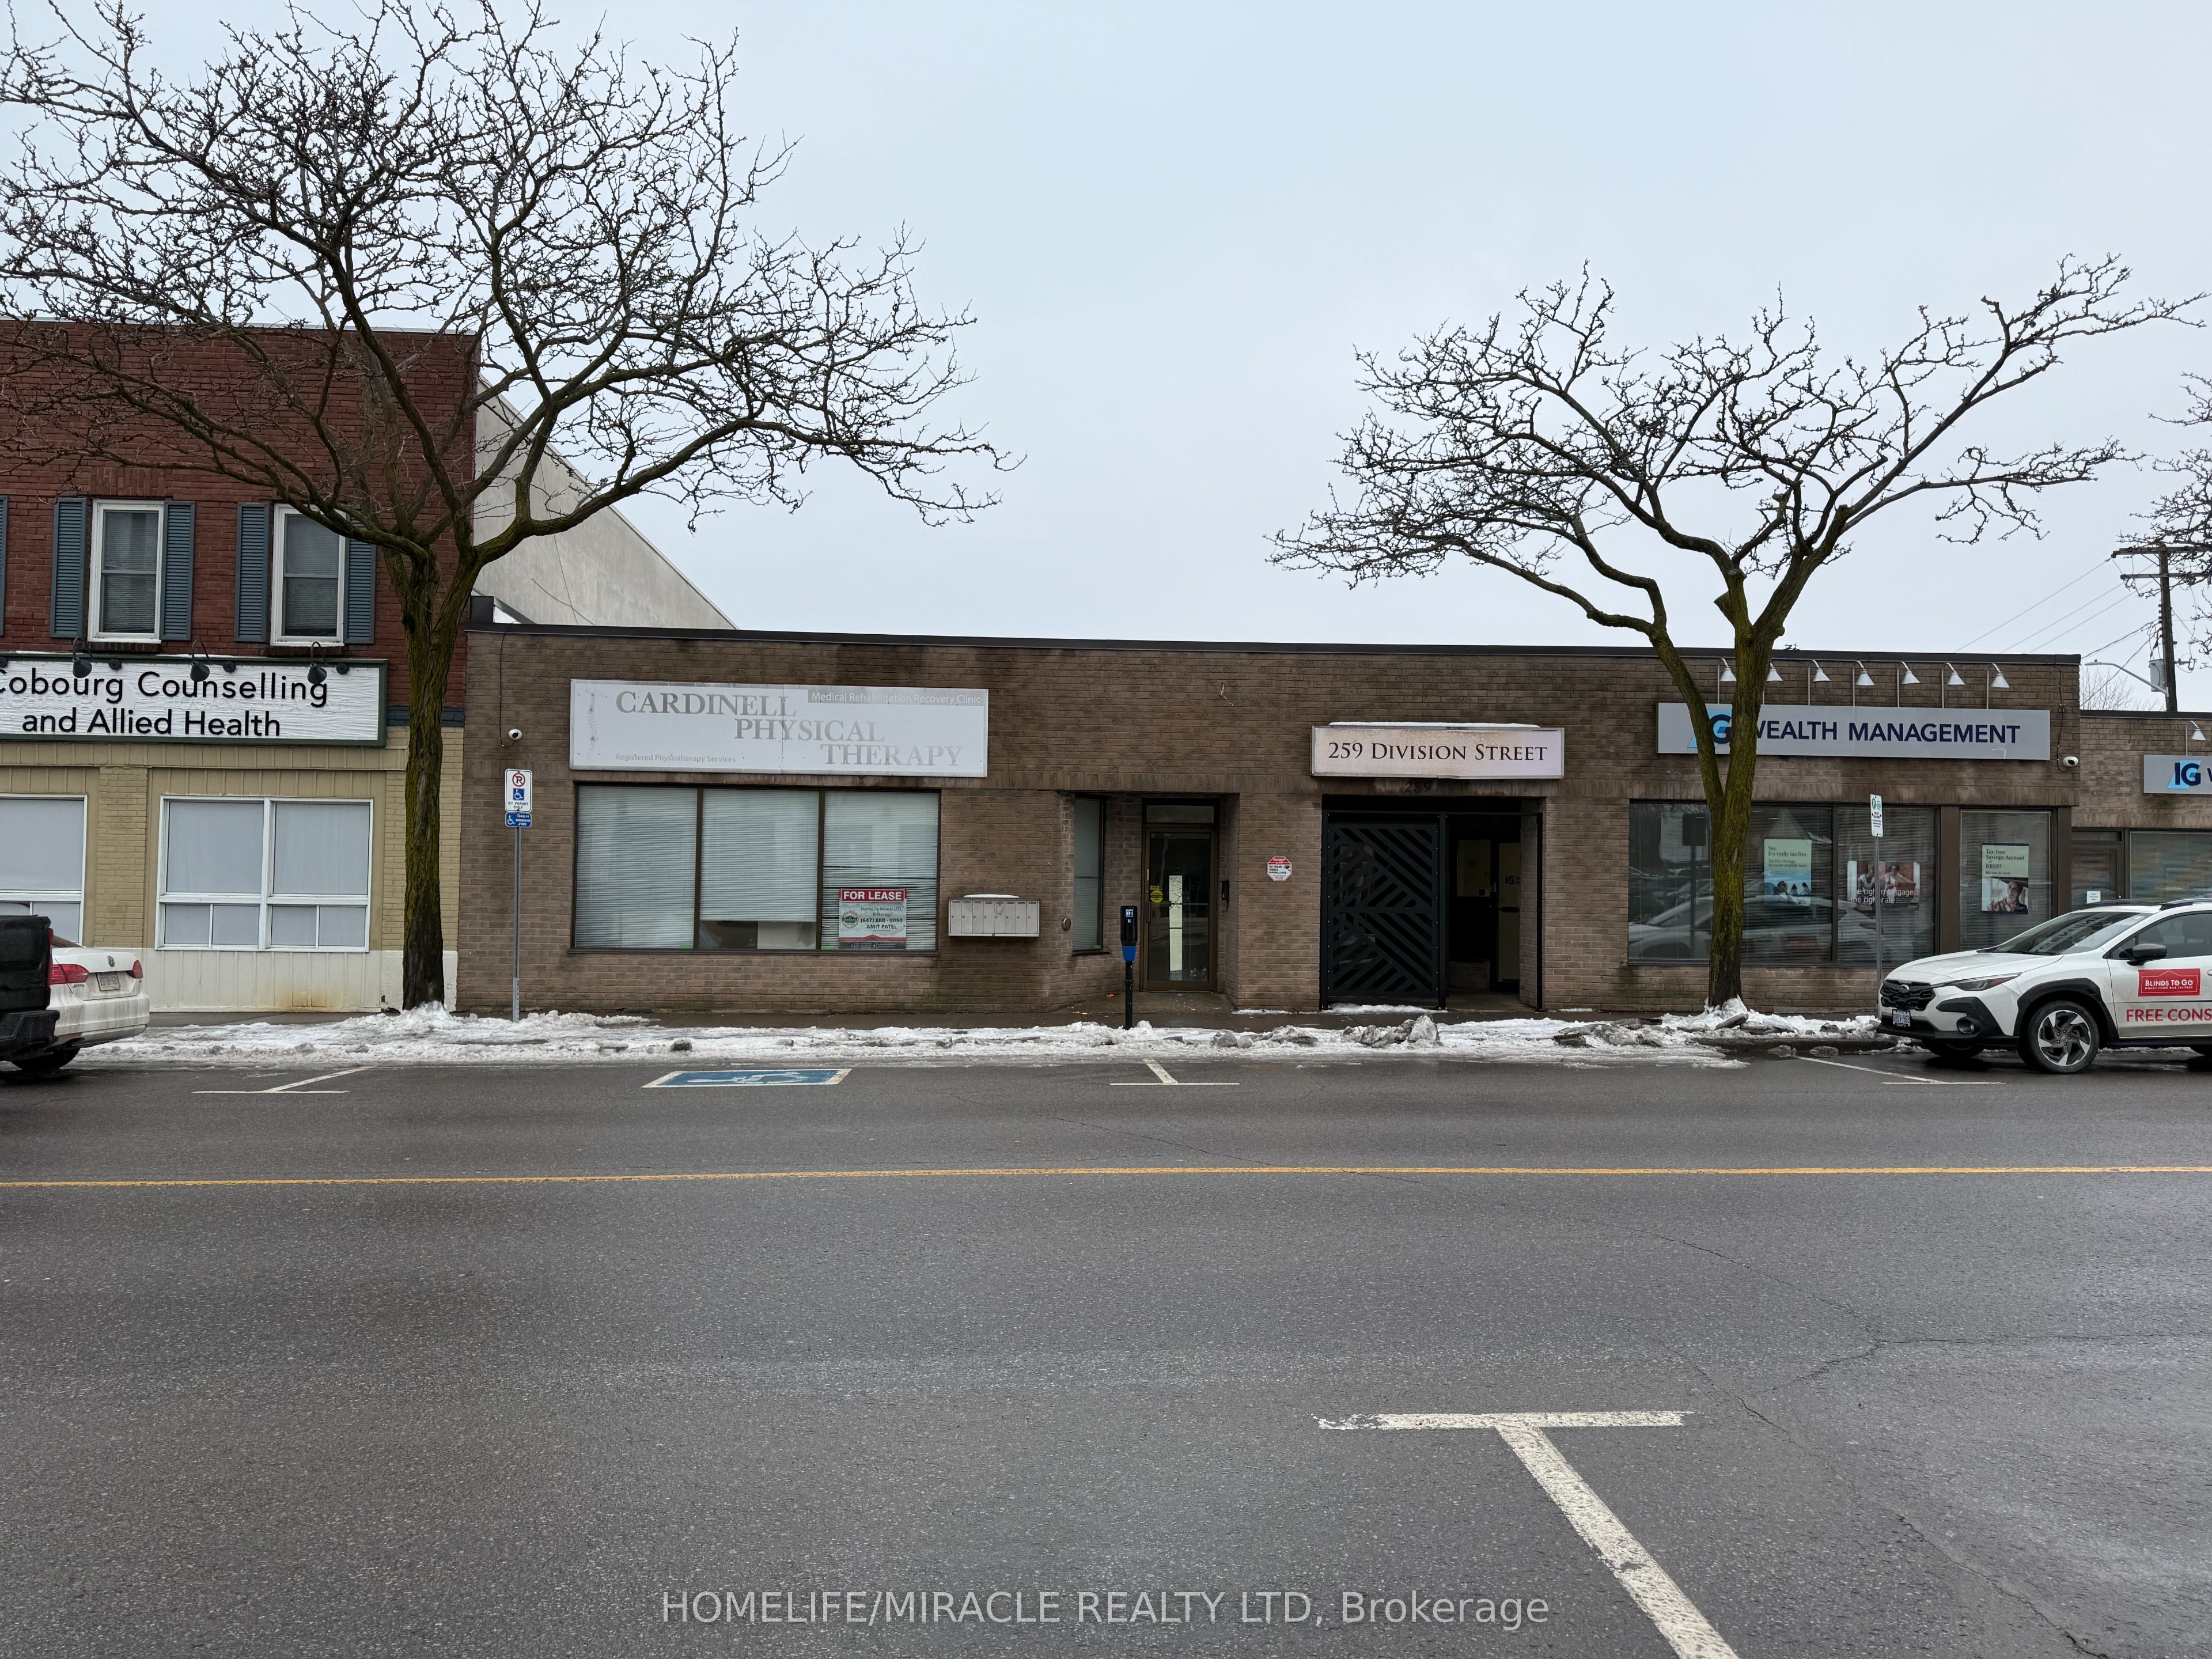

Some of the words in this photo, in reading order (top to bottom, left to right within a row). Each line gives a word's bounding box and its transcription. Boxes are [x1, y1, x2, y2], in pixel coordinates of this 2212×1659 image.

[138, 671, 327, 707] Counselling
[812, 692, 846, 701] Medical
[850, 693, 911, 702] Rehabilitation
[914, 694, 954, 704] Recovery
[956, 695, 981, 704] Clinic
[616, 691, 796, 717] CARDINELL
[22, 707, 77, 732] and
[86, 707, 172, 734] Allied
[185, 710, 280, 736] Health
[734, 718, 885, 742] PHYSICAL
[1849, 722, 2020, 744] MANAGEMENT
[615, 753, 653, 762] Registered
[654, 754, 705, 763] Physiotherapy
[820, 744, 964, 766] THERAPY
[1328, 743, 1363, 759] 259
[1371, 743, 1467, 760] DIVISION
[1475, 744, 1547, 761] STREET
[2175, 762, 2201, 786] IG
[1404, 782, 1432, 794] 259
[843, 891, 865, 900] FOR
[868, 891, 902, 900] LEASE
[1863, 888, 1876, 896] righ
[1863, 896, 1876, 904] righ
[2126, 1009, 2164, 1022] FREE
[2167, 1008, 2212, 1022] CONS
